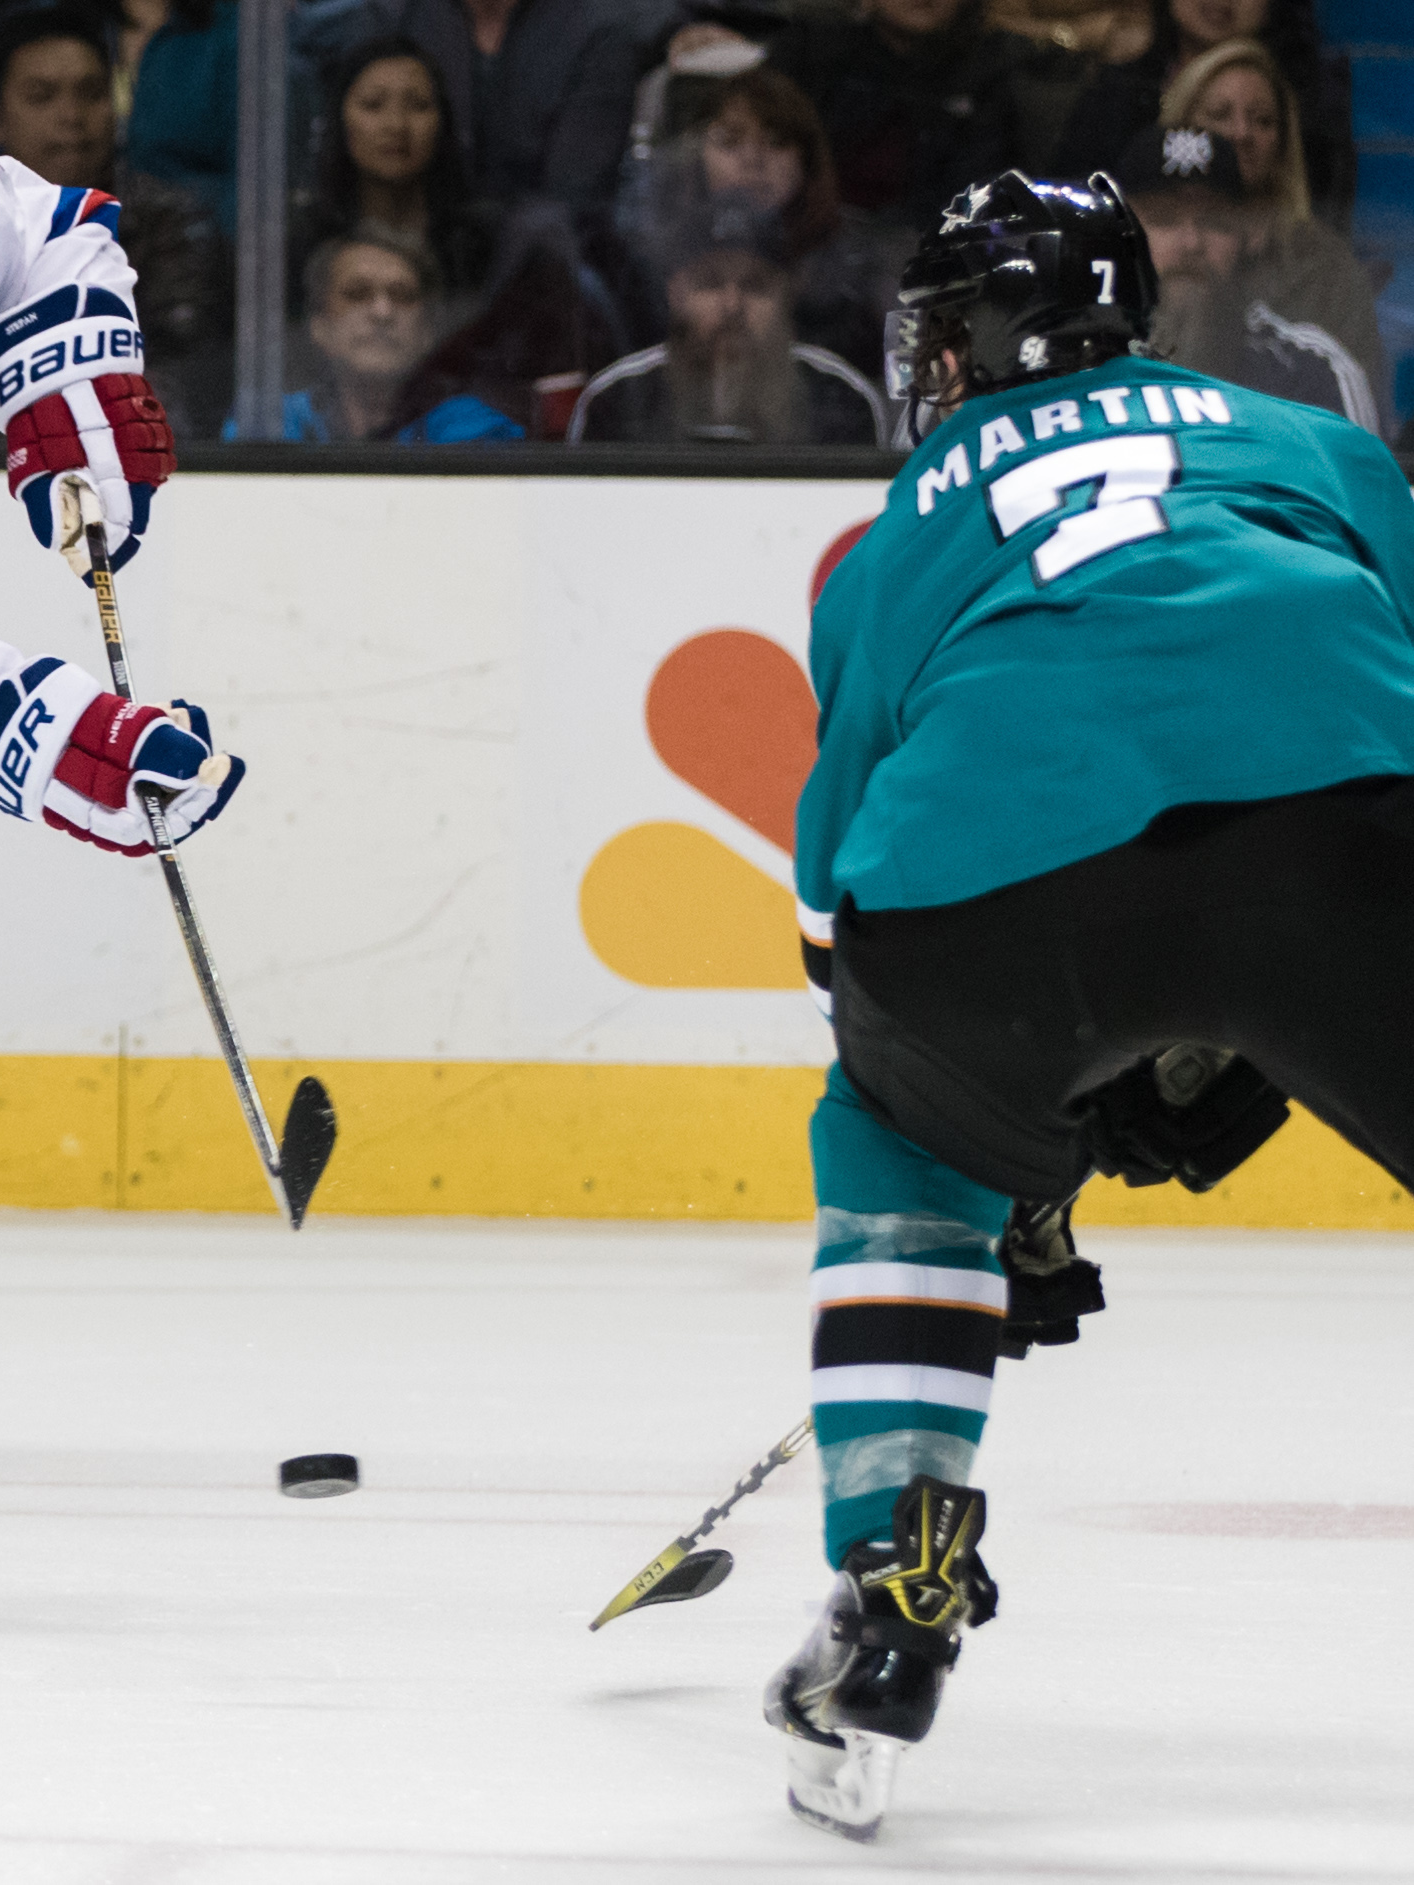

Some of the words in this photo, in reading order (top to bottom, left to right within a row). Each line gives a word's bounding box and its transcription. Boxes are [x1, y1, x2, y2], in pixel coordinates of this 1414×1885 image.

[1091, 260, 1115, 304] 7
[917, 386, 1232, 516] MARTIN
[982, 433, 1184, 588] 7
